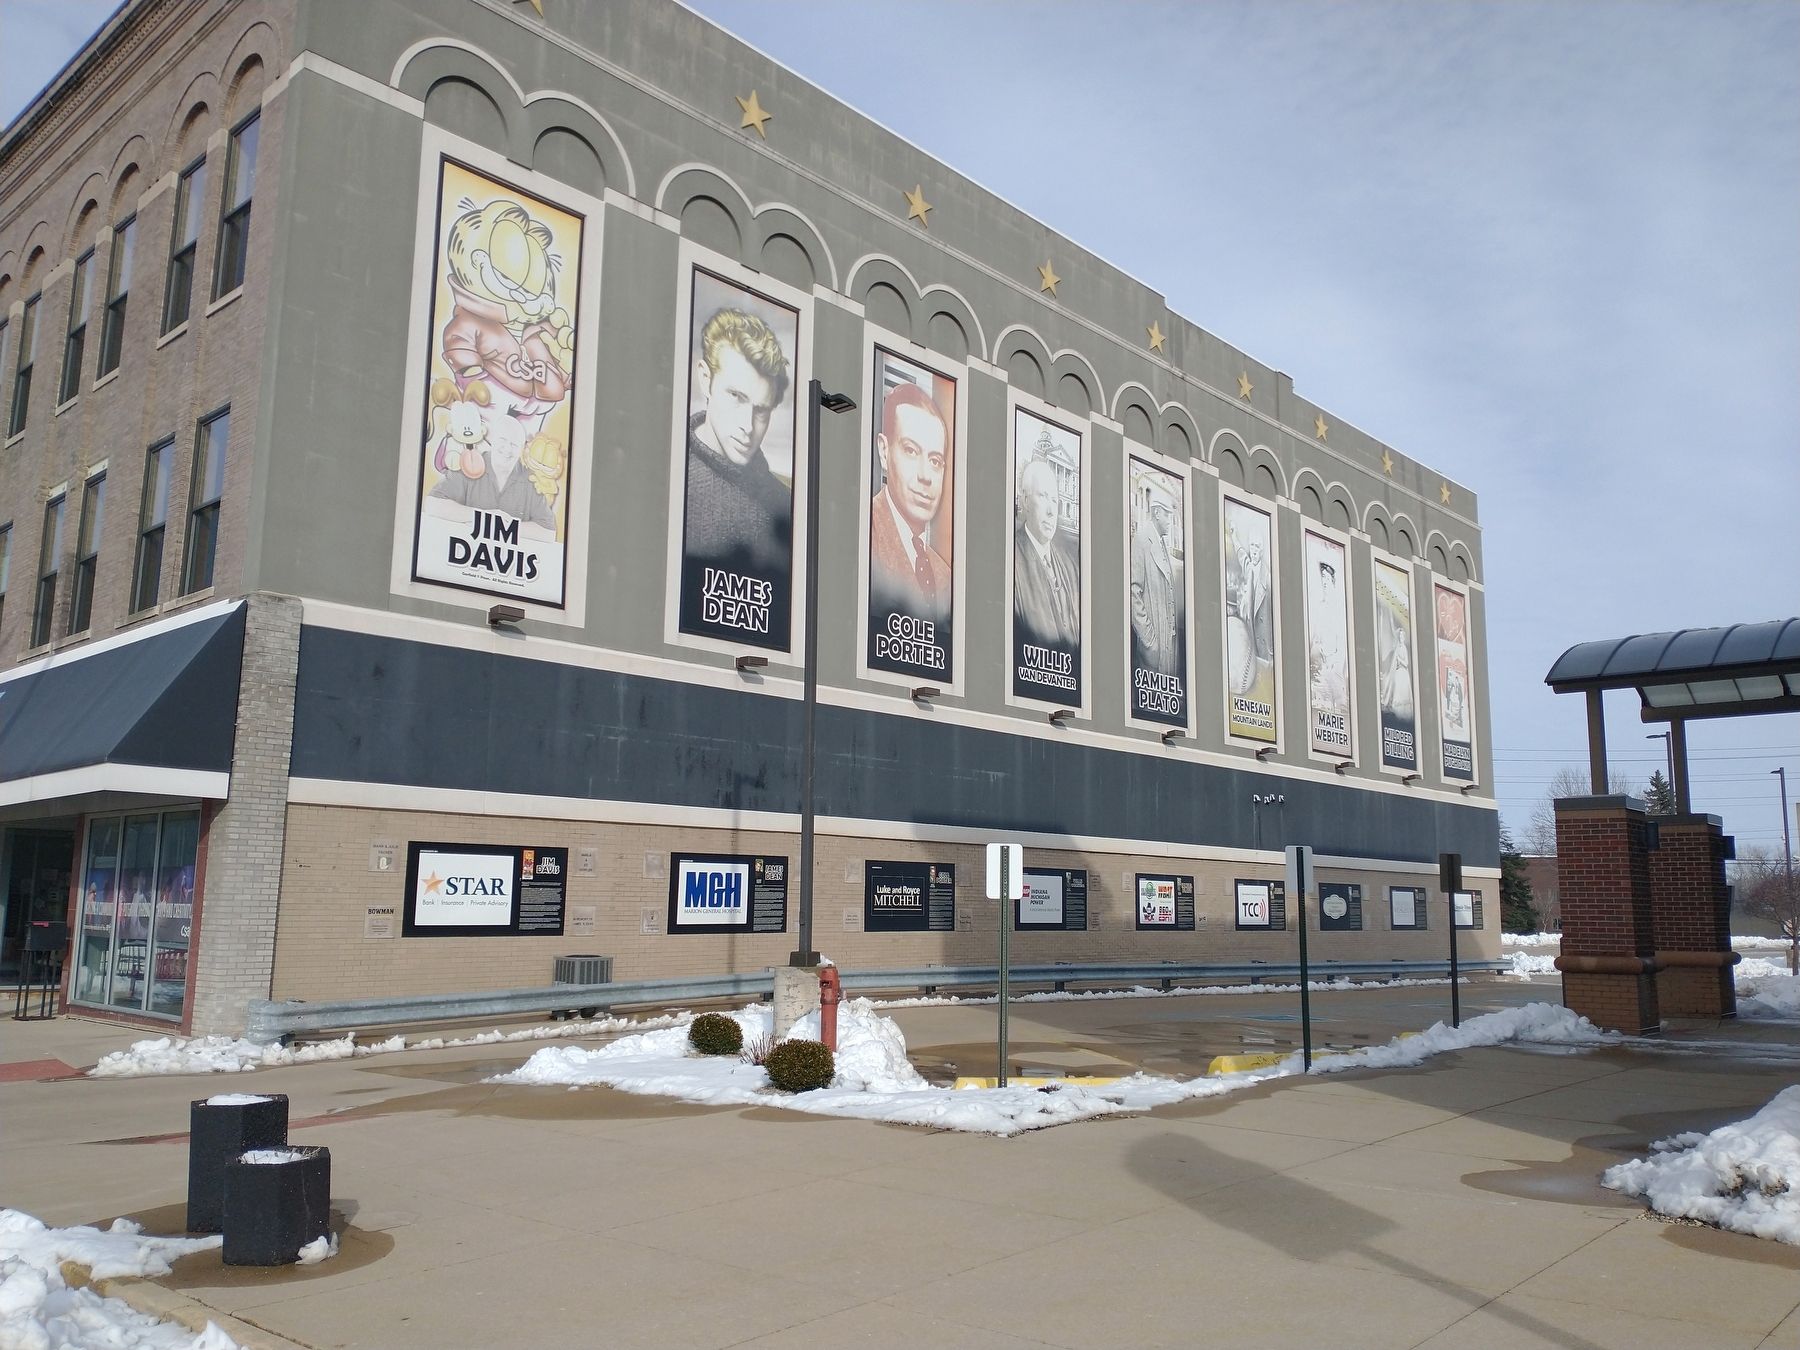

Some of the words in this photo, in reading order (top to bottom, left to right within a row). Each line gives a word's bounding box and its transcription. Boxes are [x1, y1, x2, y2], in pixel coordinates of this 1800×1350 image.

[470, 510, 519, 545] JIM
[448, 536, 538, 580] DAVIS
[703, 567, 772, 607] JAMES
[703, 595, 769, 633] DEAN
[887, 613, 934, 644] COLE
[876, 634, 945, 669] PORTER
[1023, 644, 1072, 675] WILLIS
[1018, 666, 1036, 682] VAN
[1036, 670, 1077, 690] DEVANTER
[1135, 668, 1183, 696] SAMUEL
[1138, 689, 1180, 715] PLATO
[1233, 697, 1271, 717] KENESAW
[1232, 714, 1257, 726] MOUNTAIN
[1318, 711, 1344, 730] MARIE
[1315, 727, 1348, 746] WEBSTER
[1384, 726, 1413, 746] MILDRED
[1384, 741, 1415, 760] DILLING
[536, 865, 560, 874] DAVIS
[542, 857, 555, 866] JIM
[445, 876, 507, 896] STAR
[684, 871, 742, 908] MGH
[877, 885, 891, 895] Luke
[892, 887, 902, 895] and
[903, 885, 920, 896] Royce
[874, 894, 922, 907] MITCHELL
[1242, 902, 1259, 917] TCC
